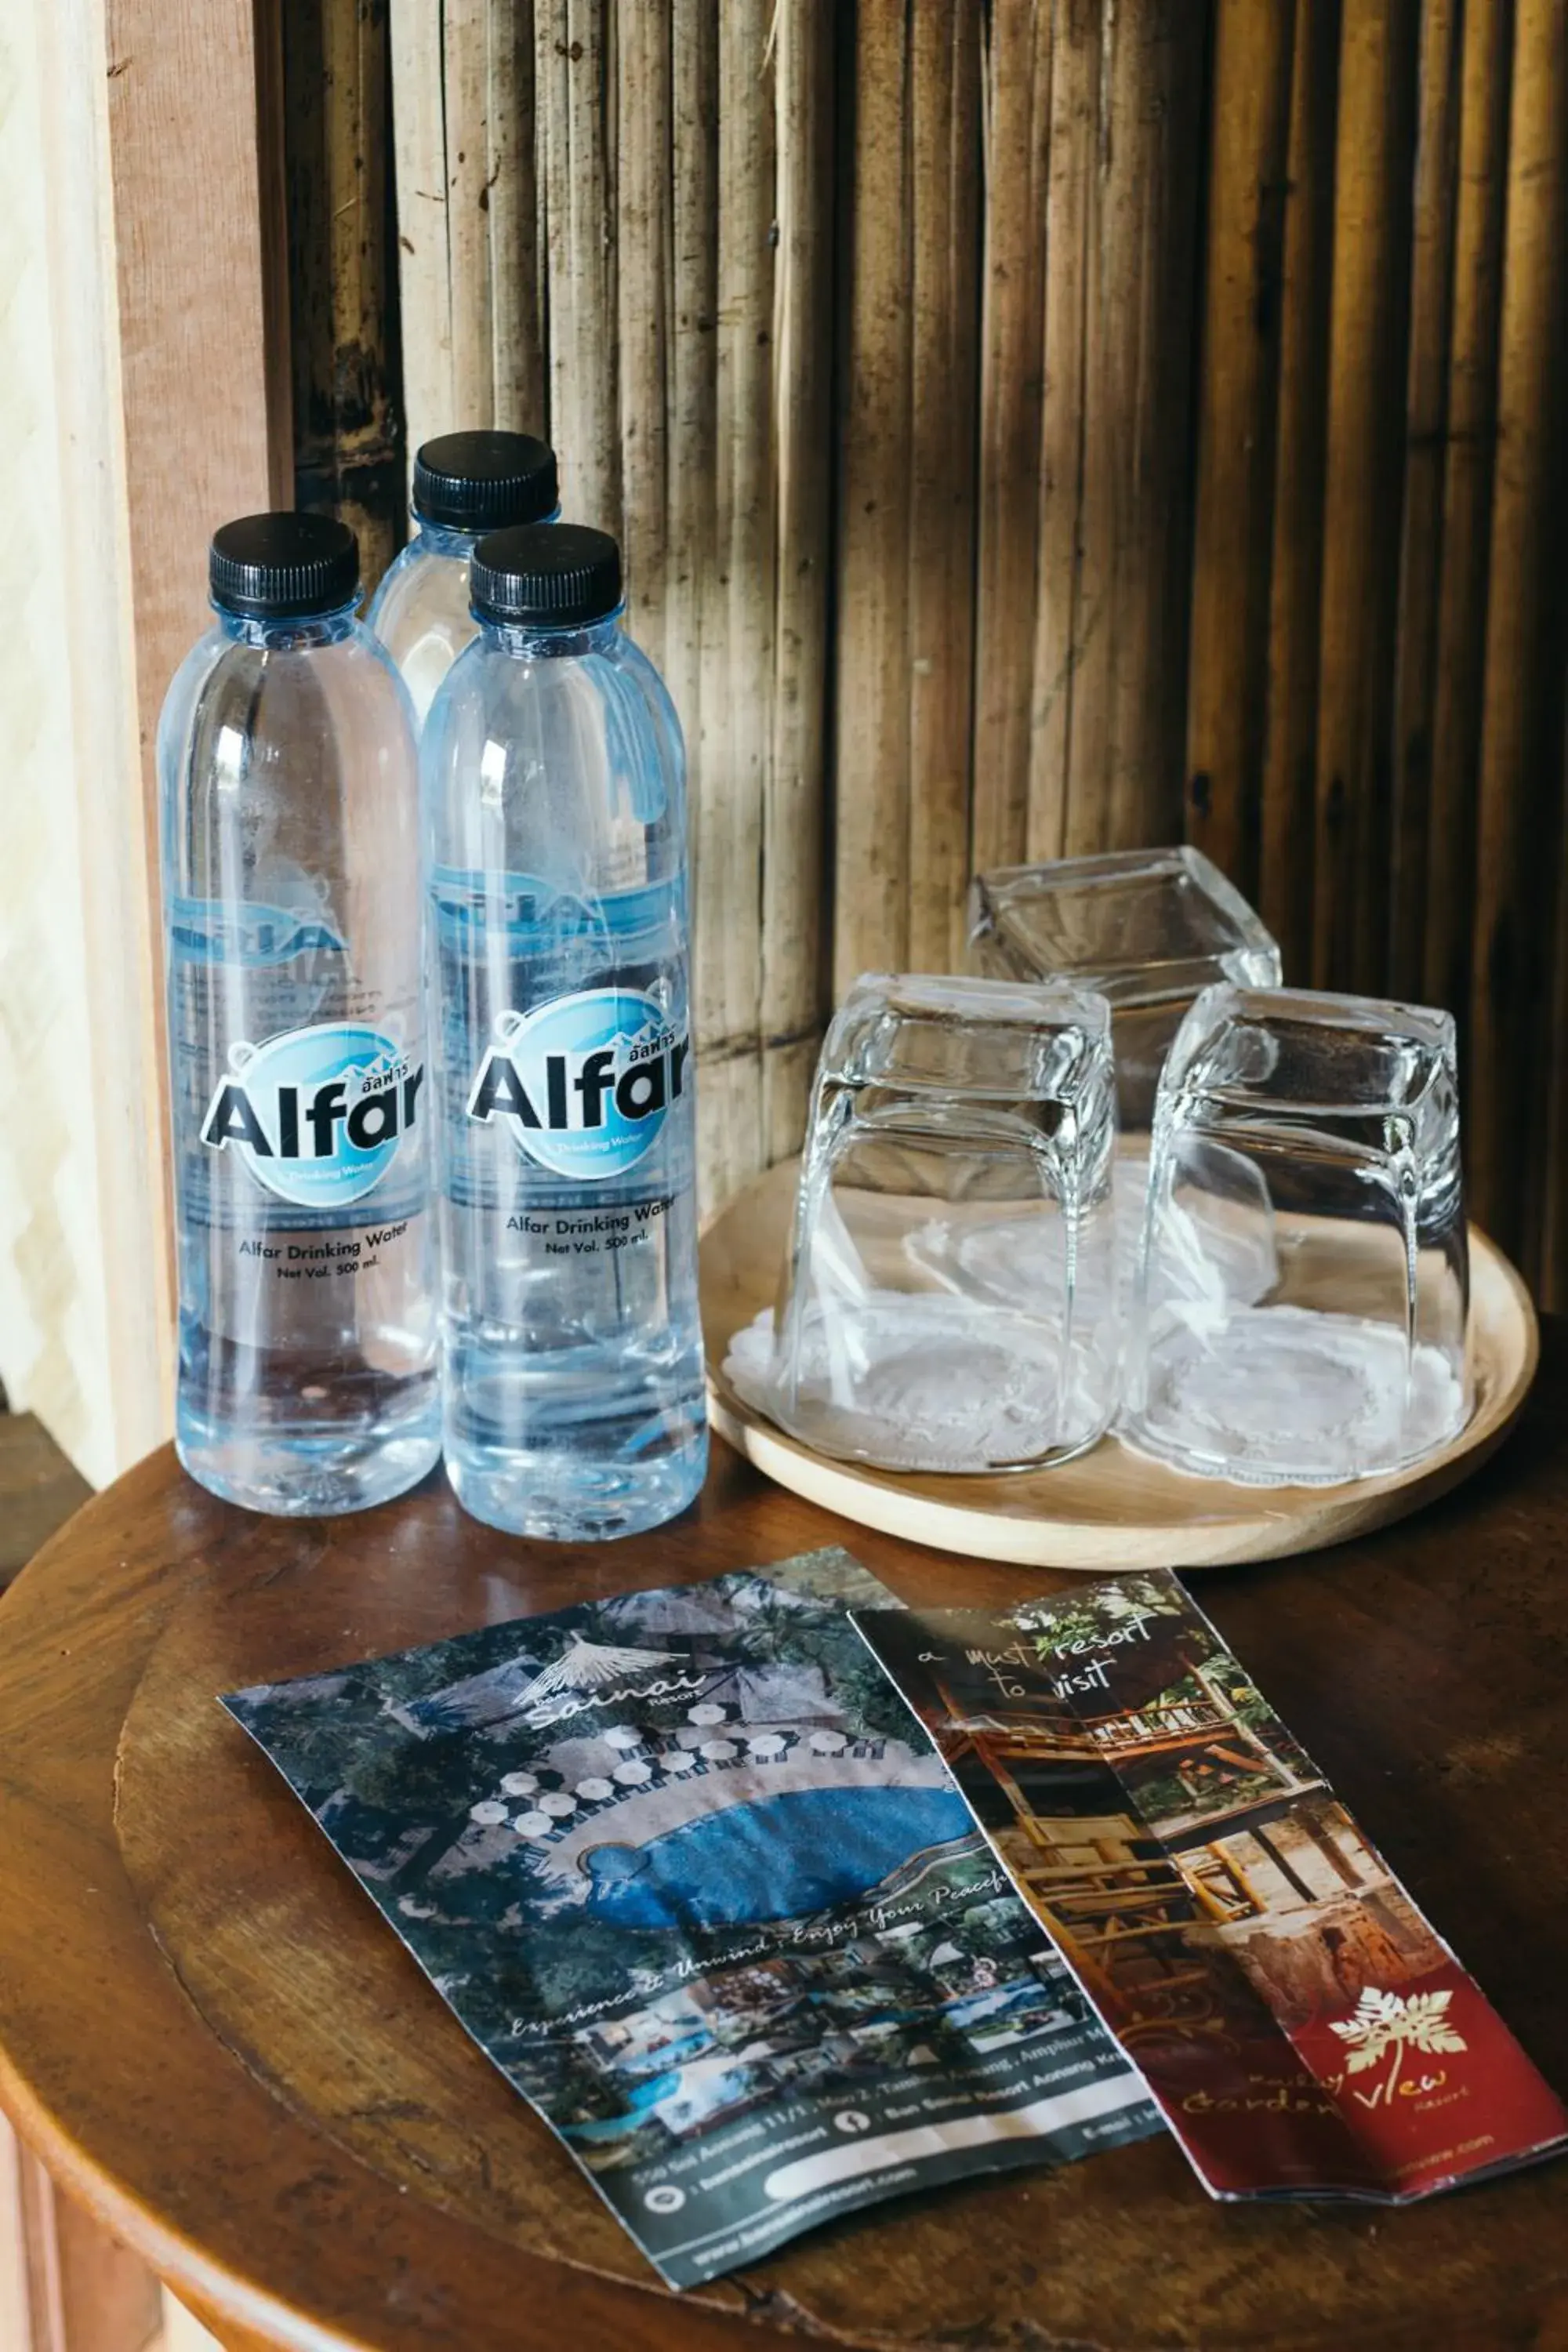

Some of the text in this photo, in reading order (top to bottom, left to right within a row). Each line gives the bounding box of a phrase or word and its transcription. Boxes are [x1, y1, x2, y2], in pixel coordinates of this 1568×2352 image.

[470, 1033, 689, 1130] Alfar
[205, 1062, 423, 1158] Alfar
[506, 1216, 549, 1234] Alfar
[556, 1215, 630, 1235] Drinking
[633, 1194, 676, 1222] Water
[239, 1240, 282, 1258] Alfar
[287, 1241, 361, 1260] Drinking
[365, 1221, 408, 1249] Water
[545, 1229, 649, 1254] Net Vol. 500 ml.
[277, 1266, 302, 1279] Net
[336, 1261, 359, 1276] 500
[917, 1611, 1159, 1671] a must resort
[524, 1668, 707, 1730] Sainai
[987, 1657, 1118, 1700] to visit
[511, 1988, 637, 2037] Experience
[672, 1936, 771, 1978] Unwind
[868, 1902, 925, 1929] Your
